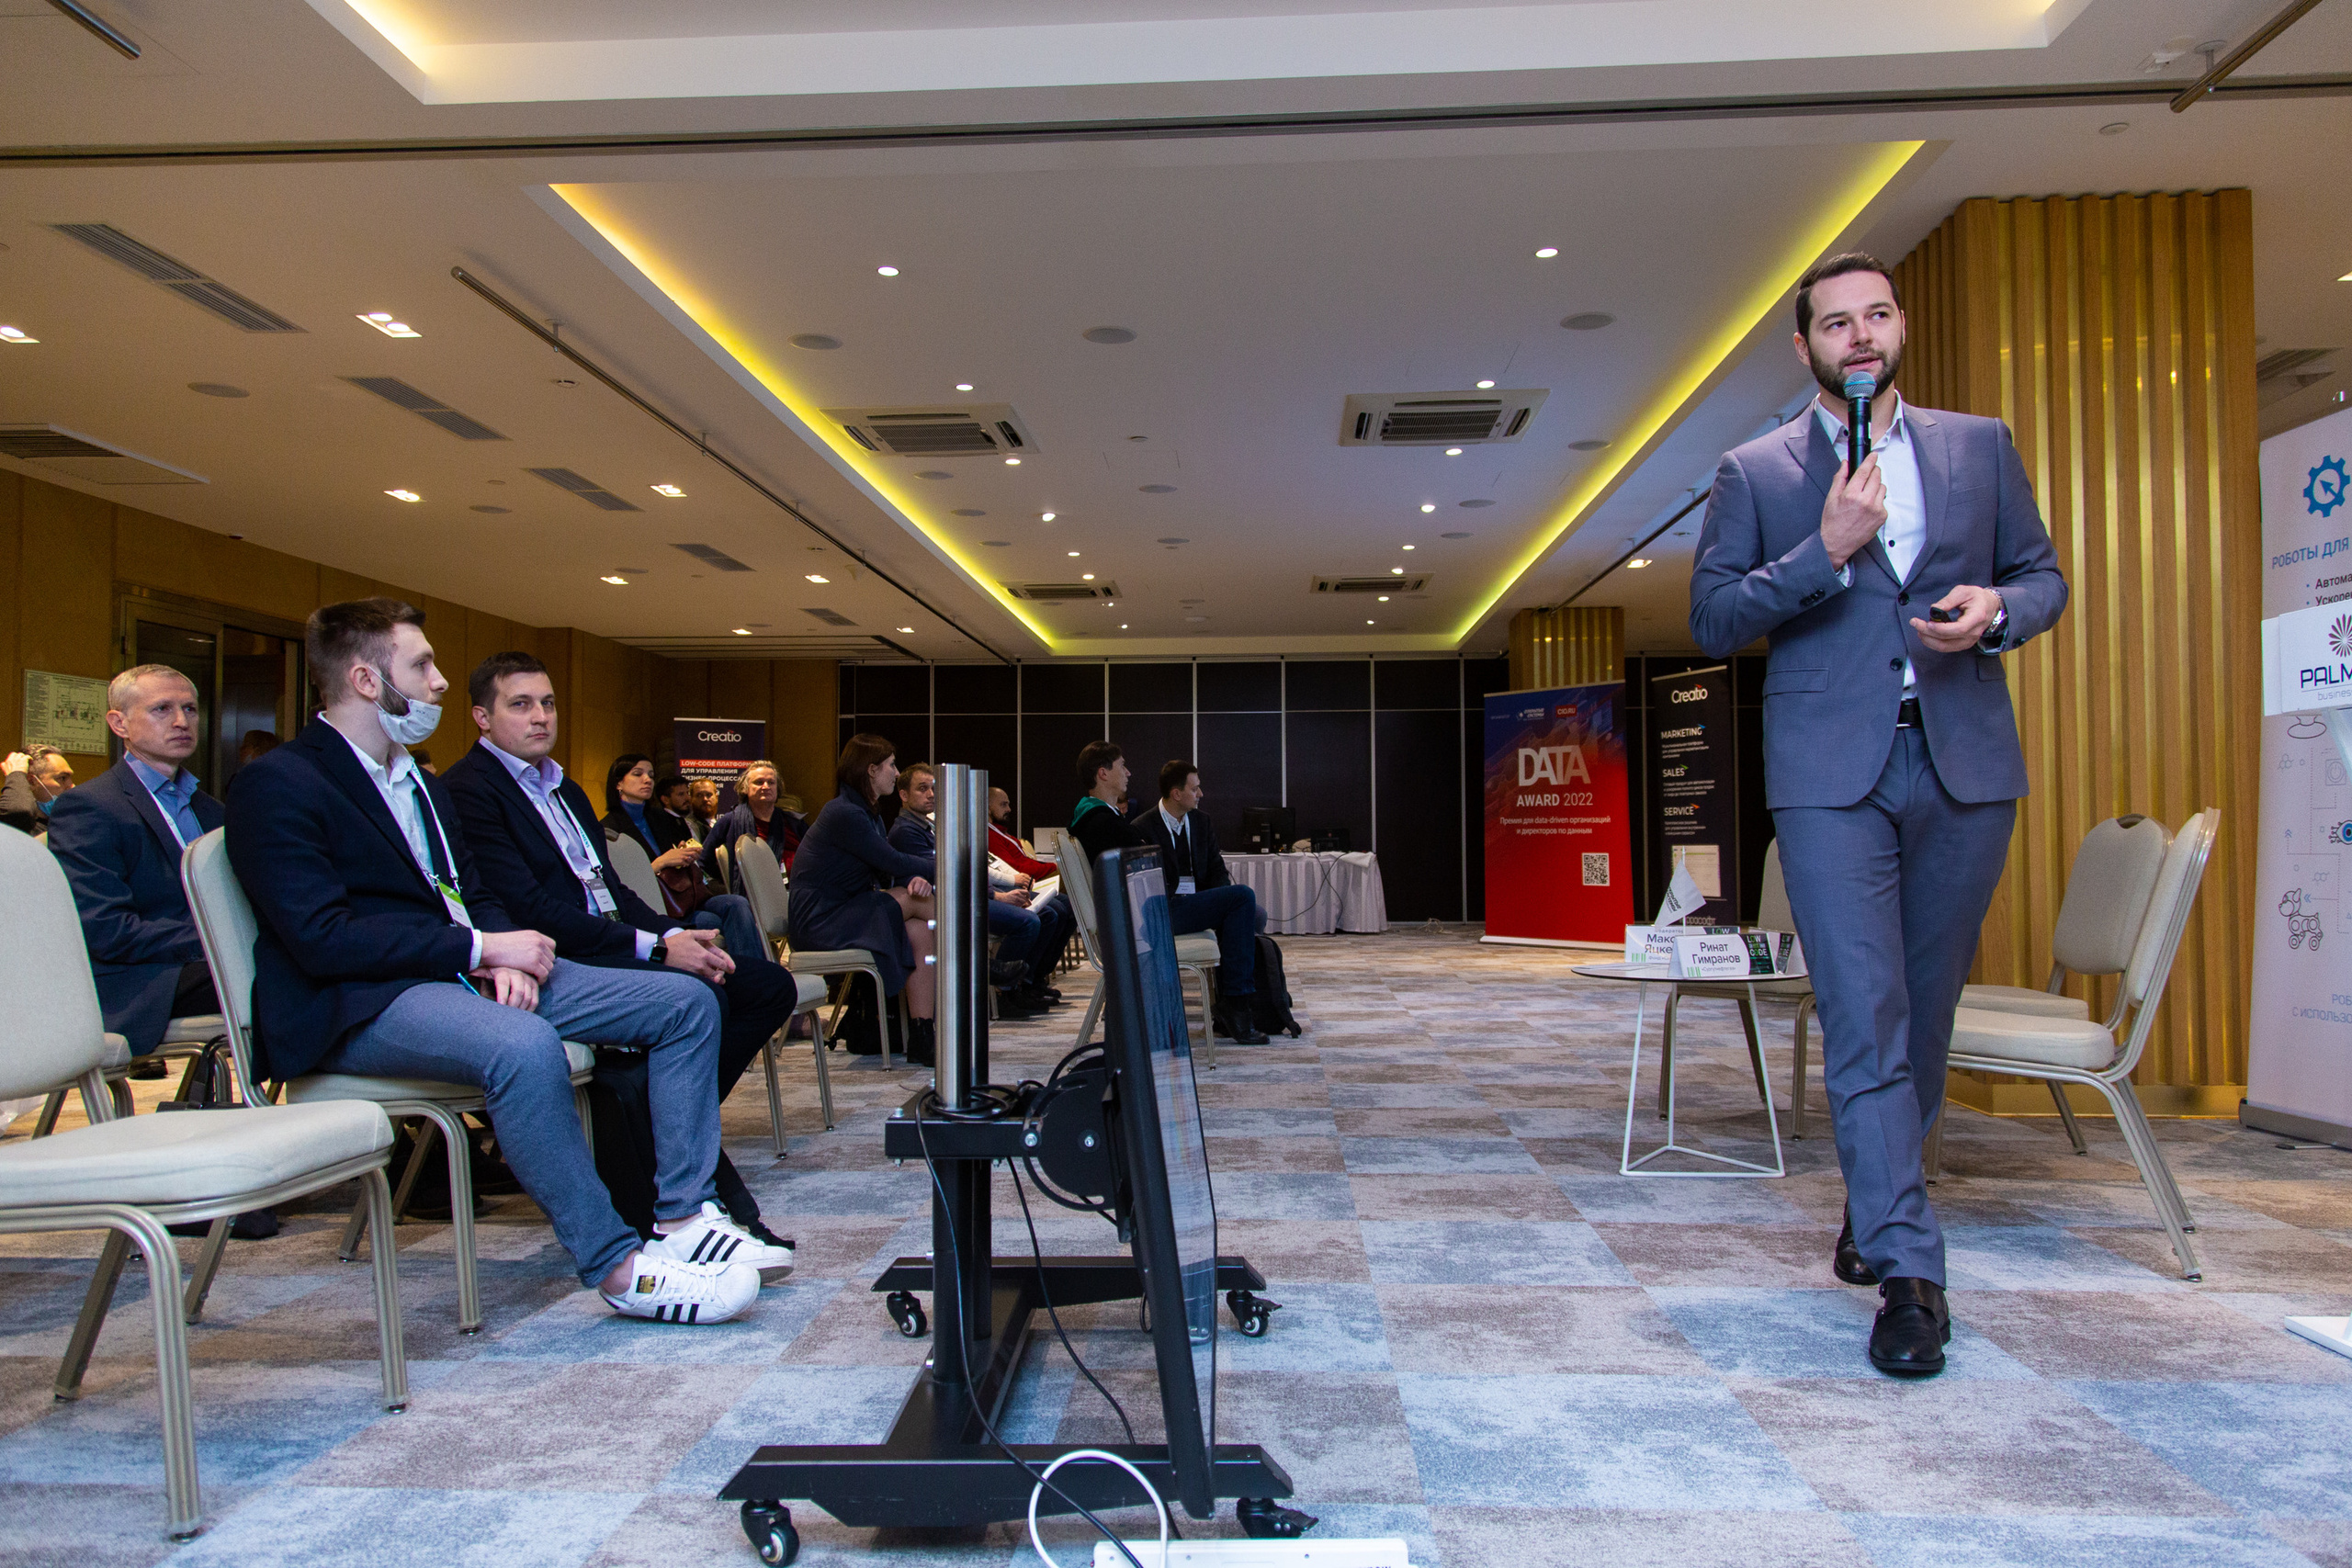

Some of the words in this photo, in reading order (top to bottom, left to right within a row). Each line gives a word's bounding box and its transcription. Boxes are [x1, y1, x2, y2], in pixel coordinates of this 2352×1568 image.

[2272, 545, 2318, 570] РОБОТЫ
[2322, 537, 2349, 559] ДЛЯ
[1671, 687, 1708, 704] Creatio
[698, 730, 741, 742] Creatio
[1661, 727, 1702, 739] MARKETING
[1519, 745, 1591, 786] DATA
[1663, 768, 1685, 777] SALES
[1517, 794, 1560, 807] AWARD
[1563, 793, 1593, 806] 2022
[1664, 807, 1694, 817] SERVICE
[1500, 817, 1522, 825] Премия
[1534, 816, 1568, 824] data-driven
[1569, 816, 1611, 825] организаций
[1747, 935, 1761, 943] LOW
[1700, 942, 1728, 953] Ринат
[1691, 953, 1740, 965] Гимранов
